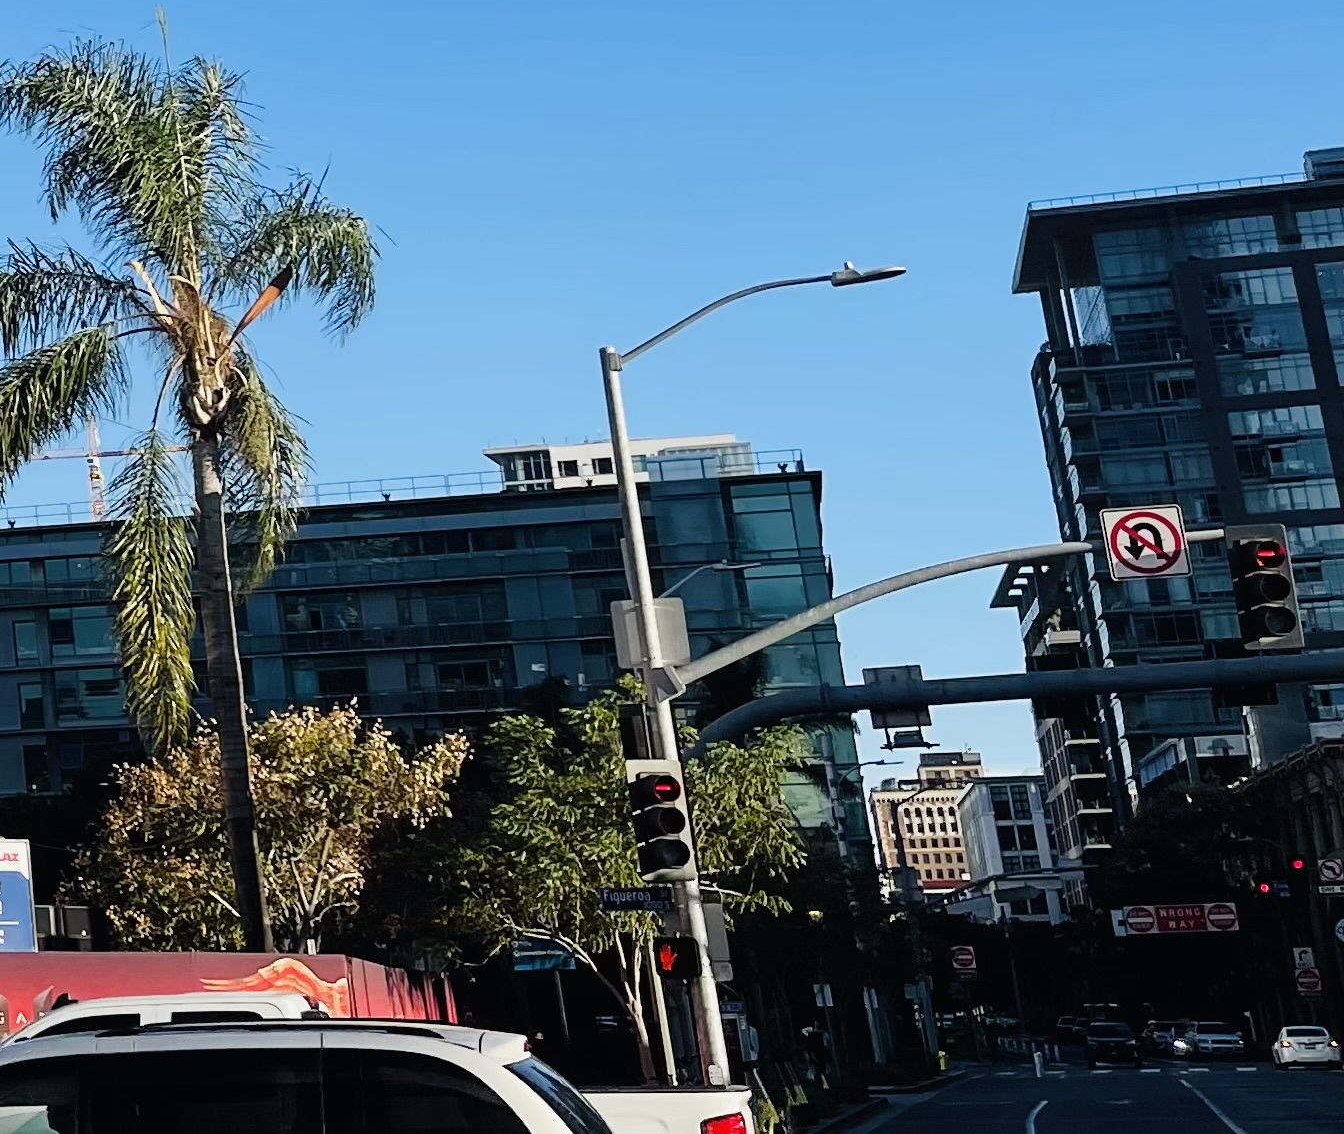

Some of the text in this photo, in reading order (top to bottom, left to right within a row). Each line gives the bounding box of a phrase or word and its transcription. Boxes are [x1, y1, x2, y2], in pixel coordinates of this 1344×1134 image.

[603, 889, 651, 906] Figueroa
[1158, 907, 1201, 918] WRONG
[1168, 919, 1195, 929] WAY
